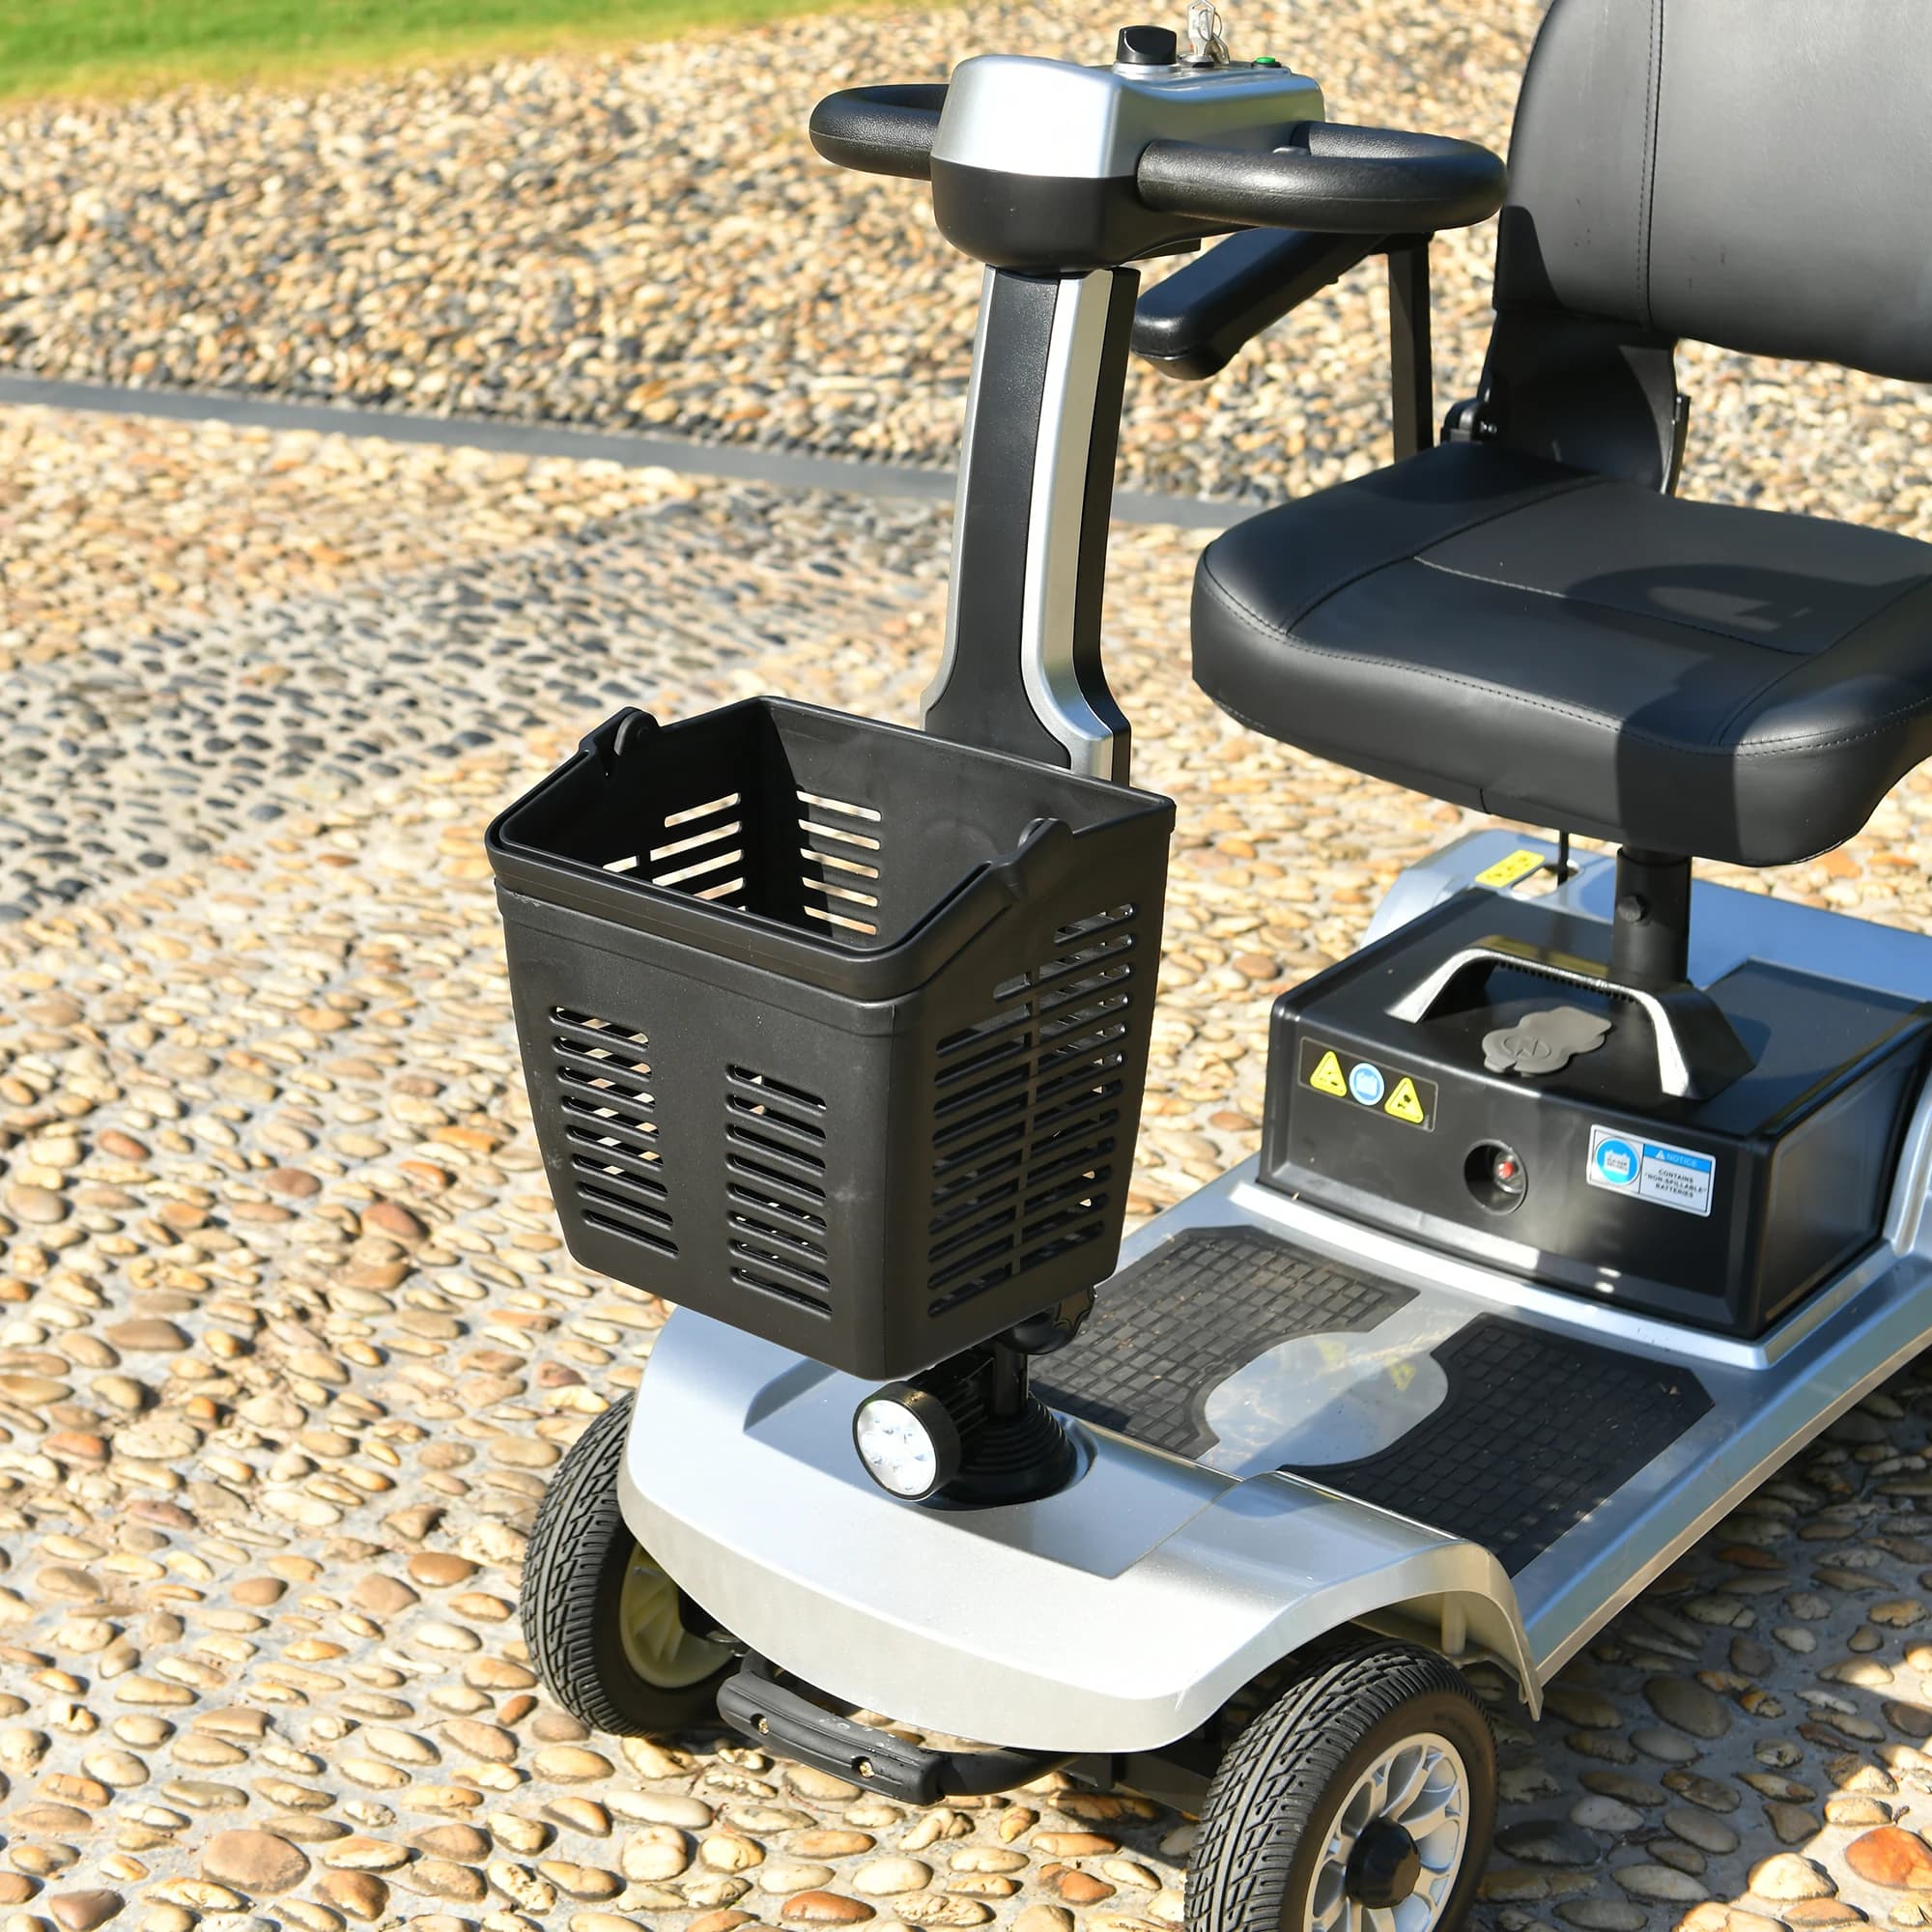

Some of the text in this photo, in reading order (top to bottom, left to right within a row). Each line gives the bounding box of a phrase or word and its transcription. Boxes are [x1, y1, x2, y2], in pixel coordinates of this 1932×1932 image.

[1666, 1153, 1697, 1167] NOTICE
[1659, 1169, 1693, 1183] CONTAINS
[1656, 1183, 1693, 1198] BATTERIES
